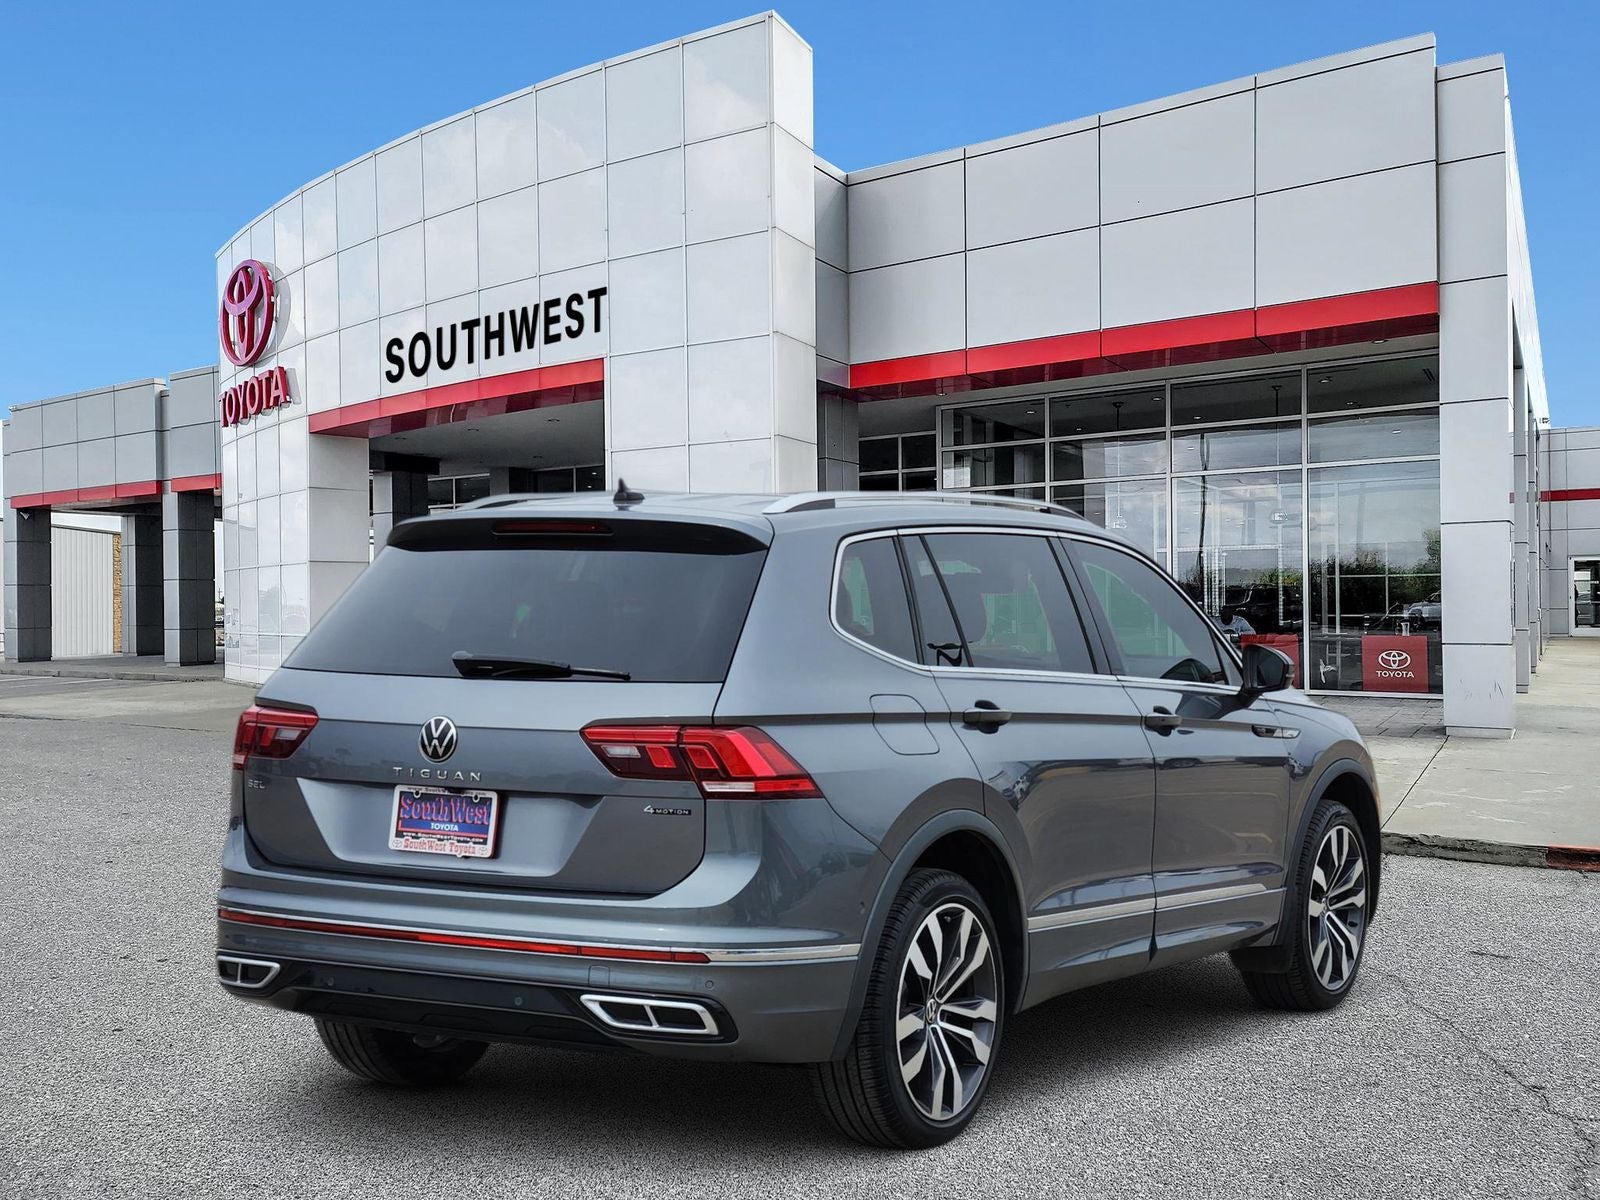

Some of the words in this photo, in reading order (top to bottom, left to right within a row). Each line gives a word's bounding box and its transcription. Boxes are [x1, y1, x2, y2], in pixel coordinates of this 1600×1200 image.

[385, 287, 608, 384] SOUTHWEST
[219, 366, 291, 428] TOYOTA
[1376, 670, 1415, 678] TOYOTA
[393, 767, 481, 782] TIGUAN
[430, 822, 459, 832] TOYOTA
[449, 841, 476, 856] Toyota
